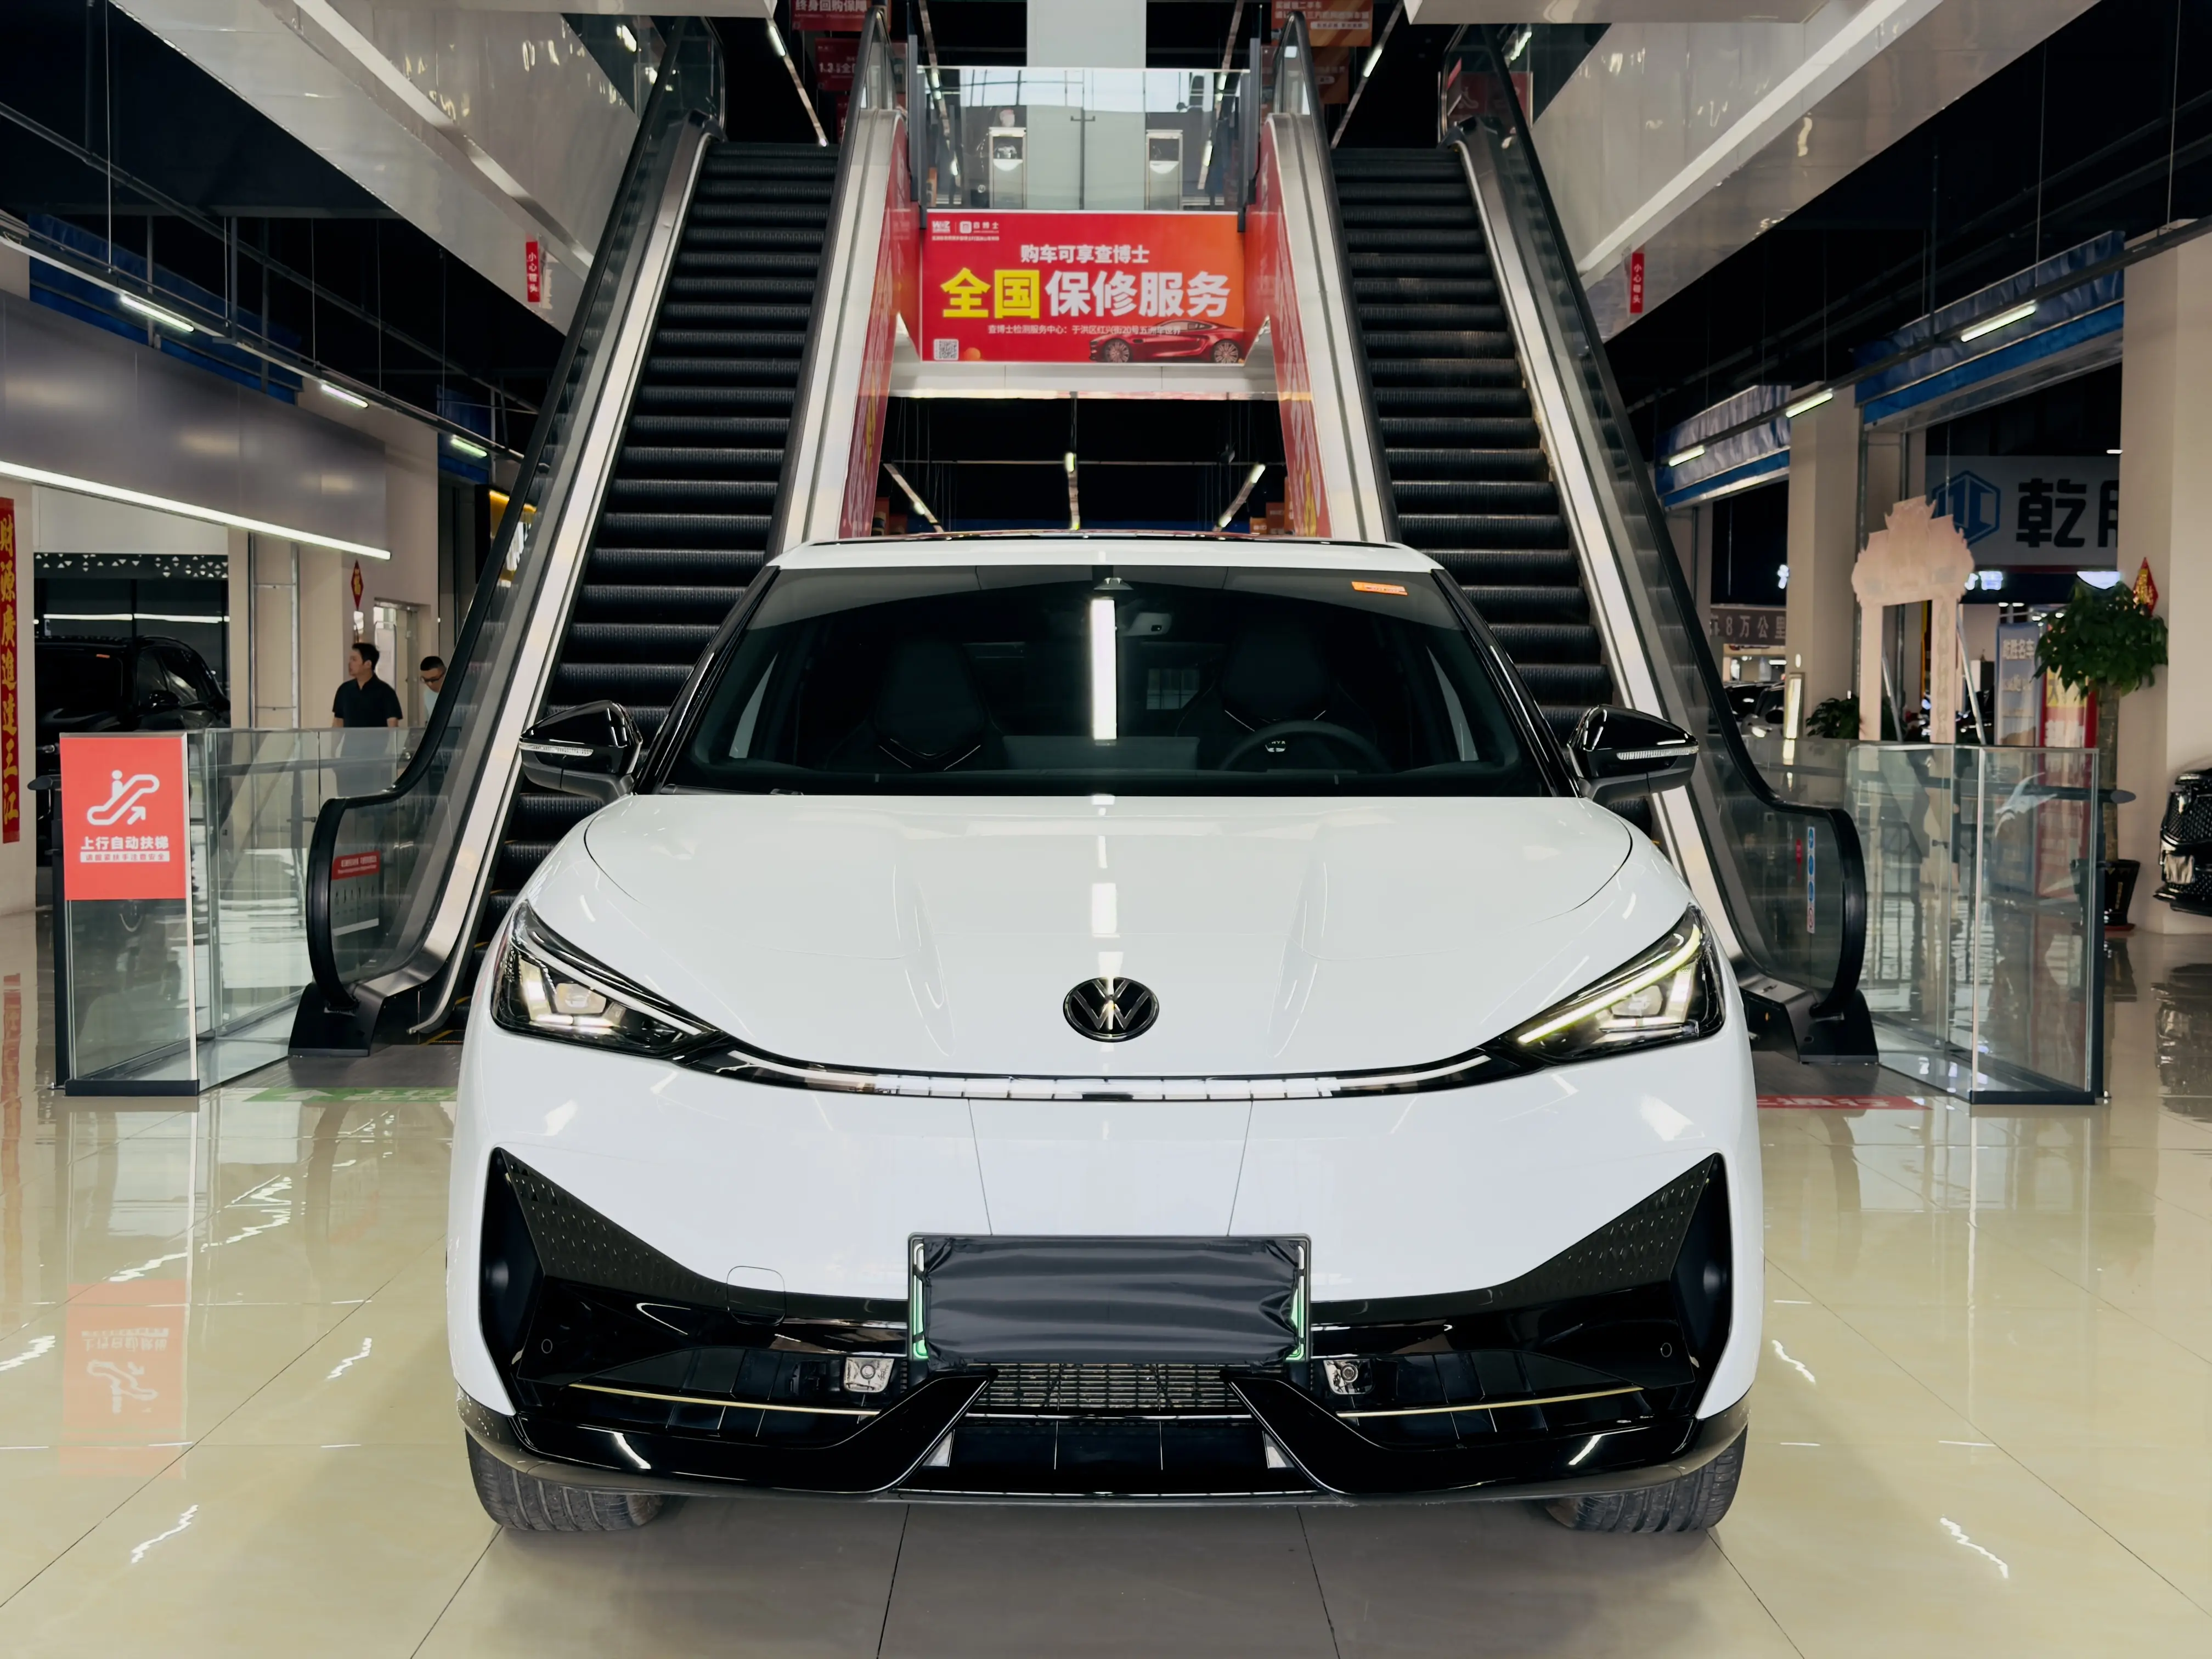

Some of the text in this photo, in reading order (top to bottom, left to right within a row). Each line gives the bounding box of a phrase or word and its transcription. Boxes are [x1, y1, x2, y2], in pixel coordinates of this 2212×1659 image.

[1020, 244, 1150, 263] 购车可享查博士
[940, 267, 1231, 319] 全国保修服务
[81, 836, 169, 850] 上行自动扶梯
